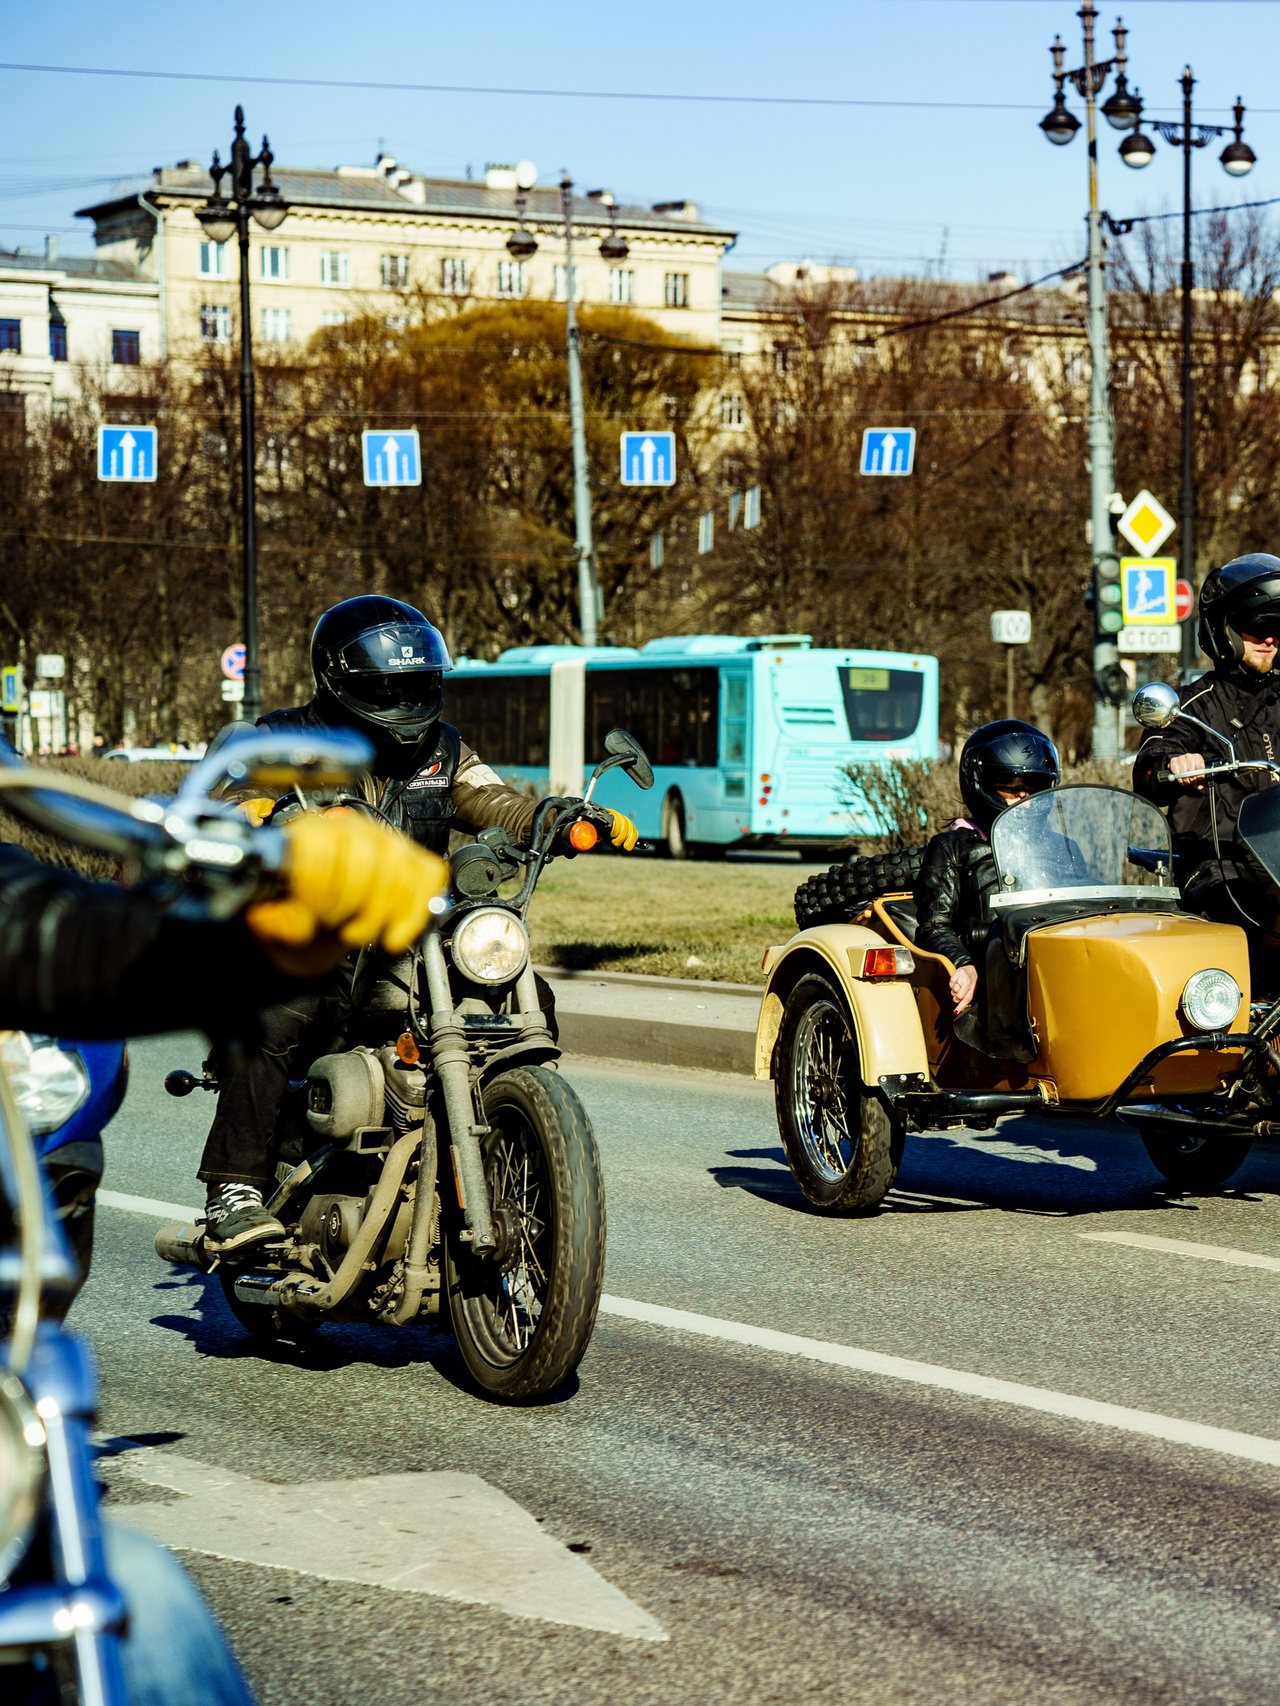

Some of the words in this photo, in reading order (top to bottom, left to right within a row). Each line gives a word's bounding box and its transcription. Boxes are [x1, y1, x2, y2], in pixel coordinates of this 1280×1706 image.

[1125, 631, 1171, 647] СТОП
[388, 657, 425, 666] SHARK
[332, 1217, 337, 1230] 5
